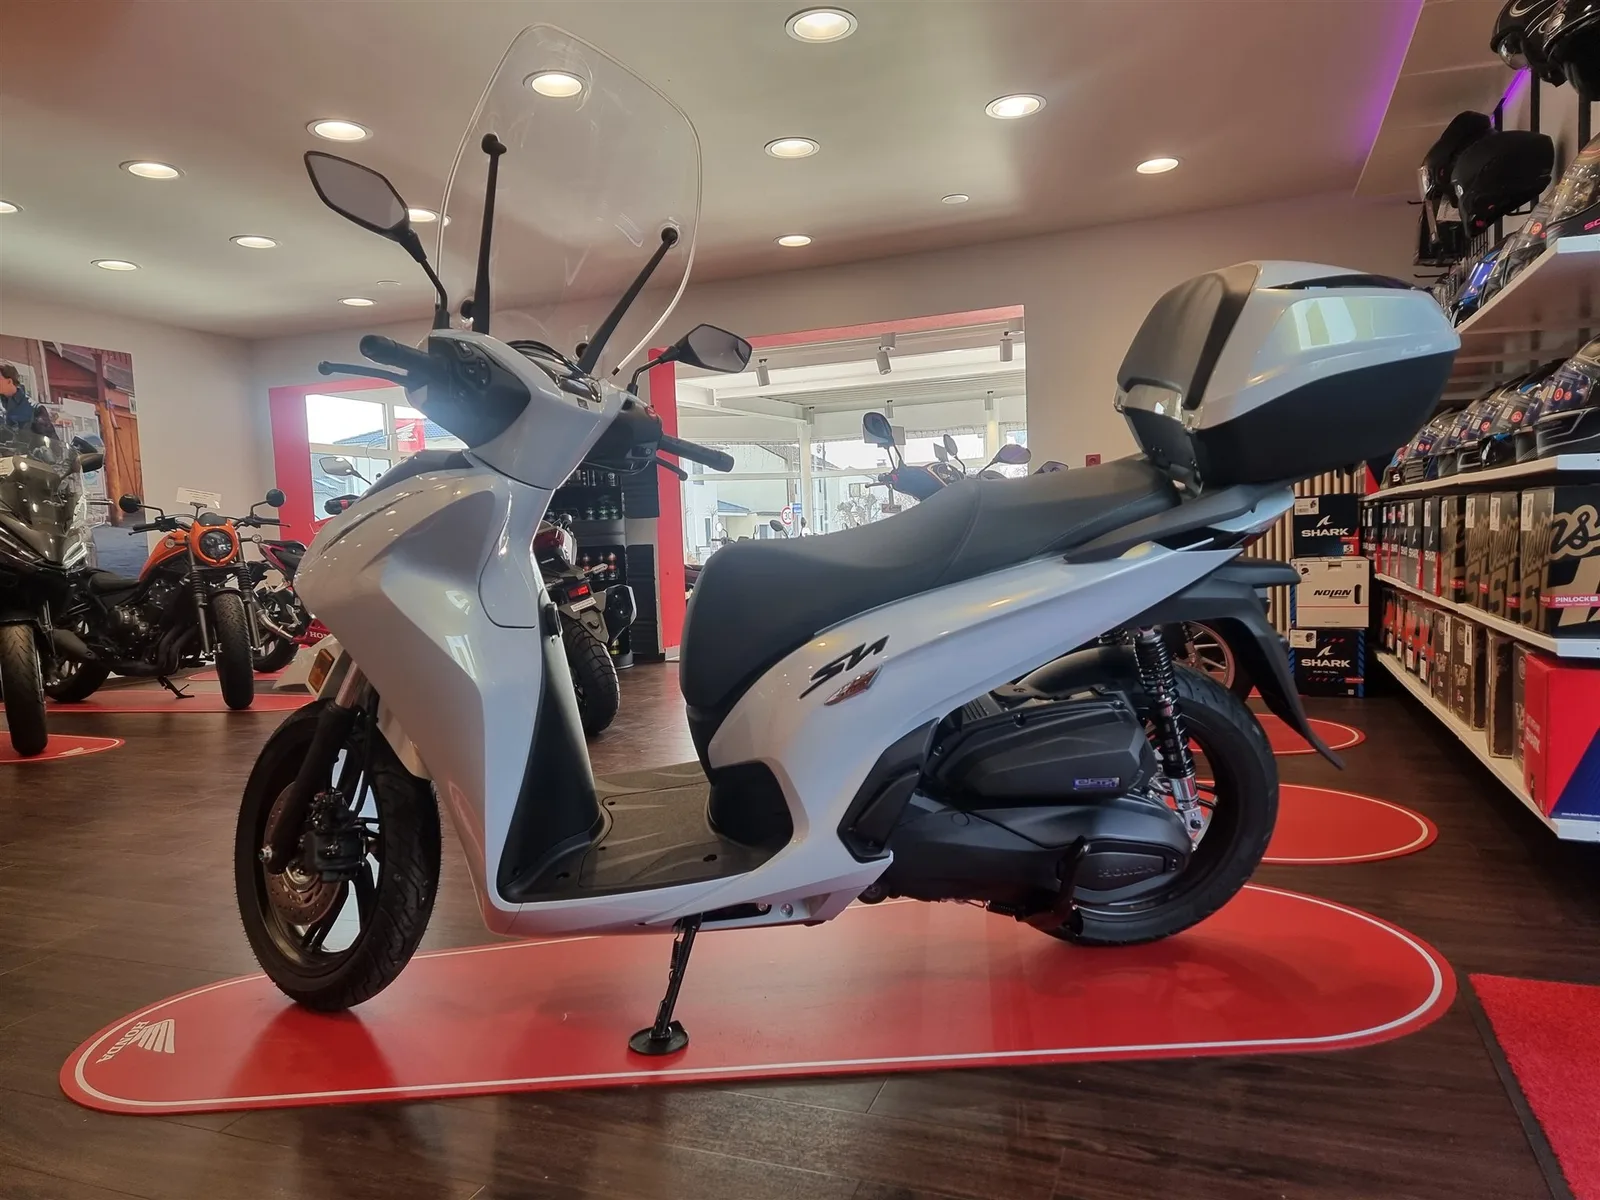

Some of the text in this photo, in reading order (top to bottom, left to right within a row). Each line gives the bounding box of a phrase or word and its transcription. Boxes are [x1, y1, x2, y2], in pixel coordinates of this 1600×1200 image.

[1301, 528, 1349, 537] SHARK
[1313, 589, 1352, 598] NOLAN
[1301, 658, 1351, 668] SHARK
[96, 1020, 149, 1064] HONDA
